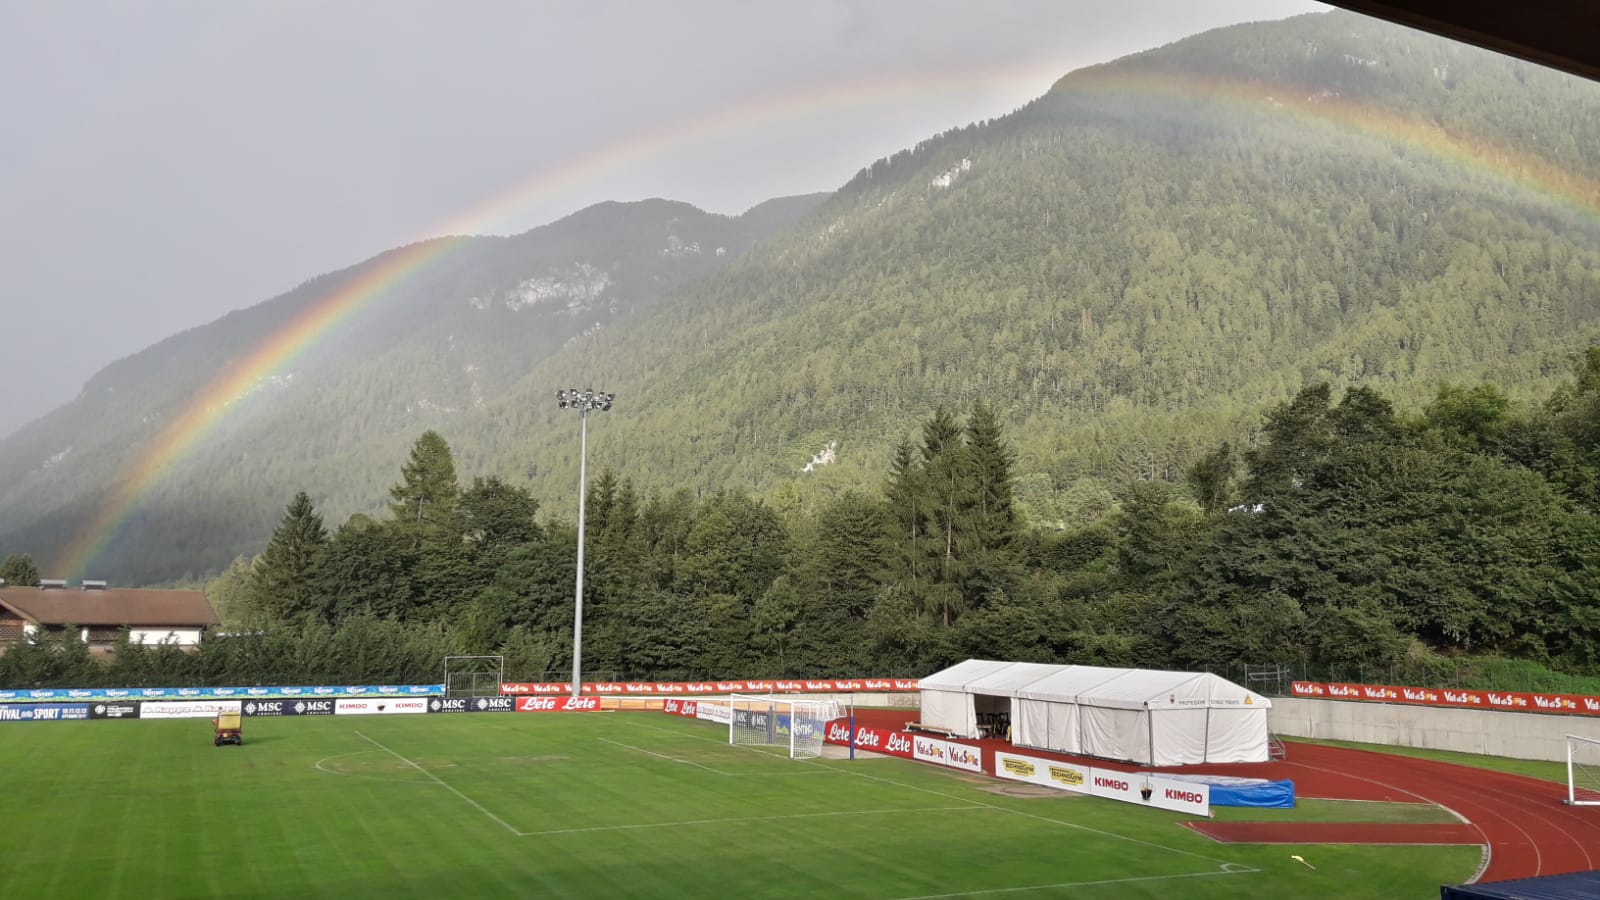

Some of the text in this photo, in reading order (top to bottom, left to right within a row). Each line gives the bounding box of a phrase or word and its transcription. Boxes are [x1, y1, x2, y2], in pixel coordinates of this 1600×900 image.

[258, 702, 282, 711] MSC
[307, 702, 331, 710] MSC
[442, 700, 465, 708] MSC
[489, 699, 511, 707] MSC
[520, 697, 596, 710] Lete Lete
[33, 708, 59, 719] SPORT
[828, 723, 849, 741] Lete
[855, 728, 879, 746] Lete
[886, 733, 910, 752] Lete
[1095, 777, 1128, 791] KIMBO
[1166, 789, 1202, 803] KIMBO
